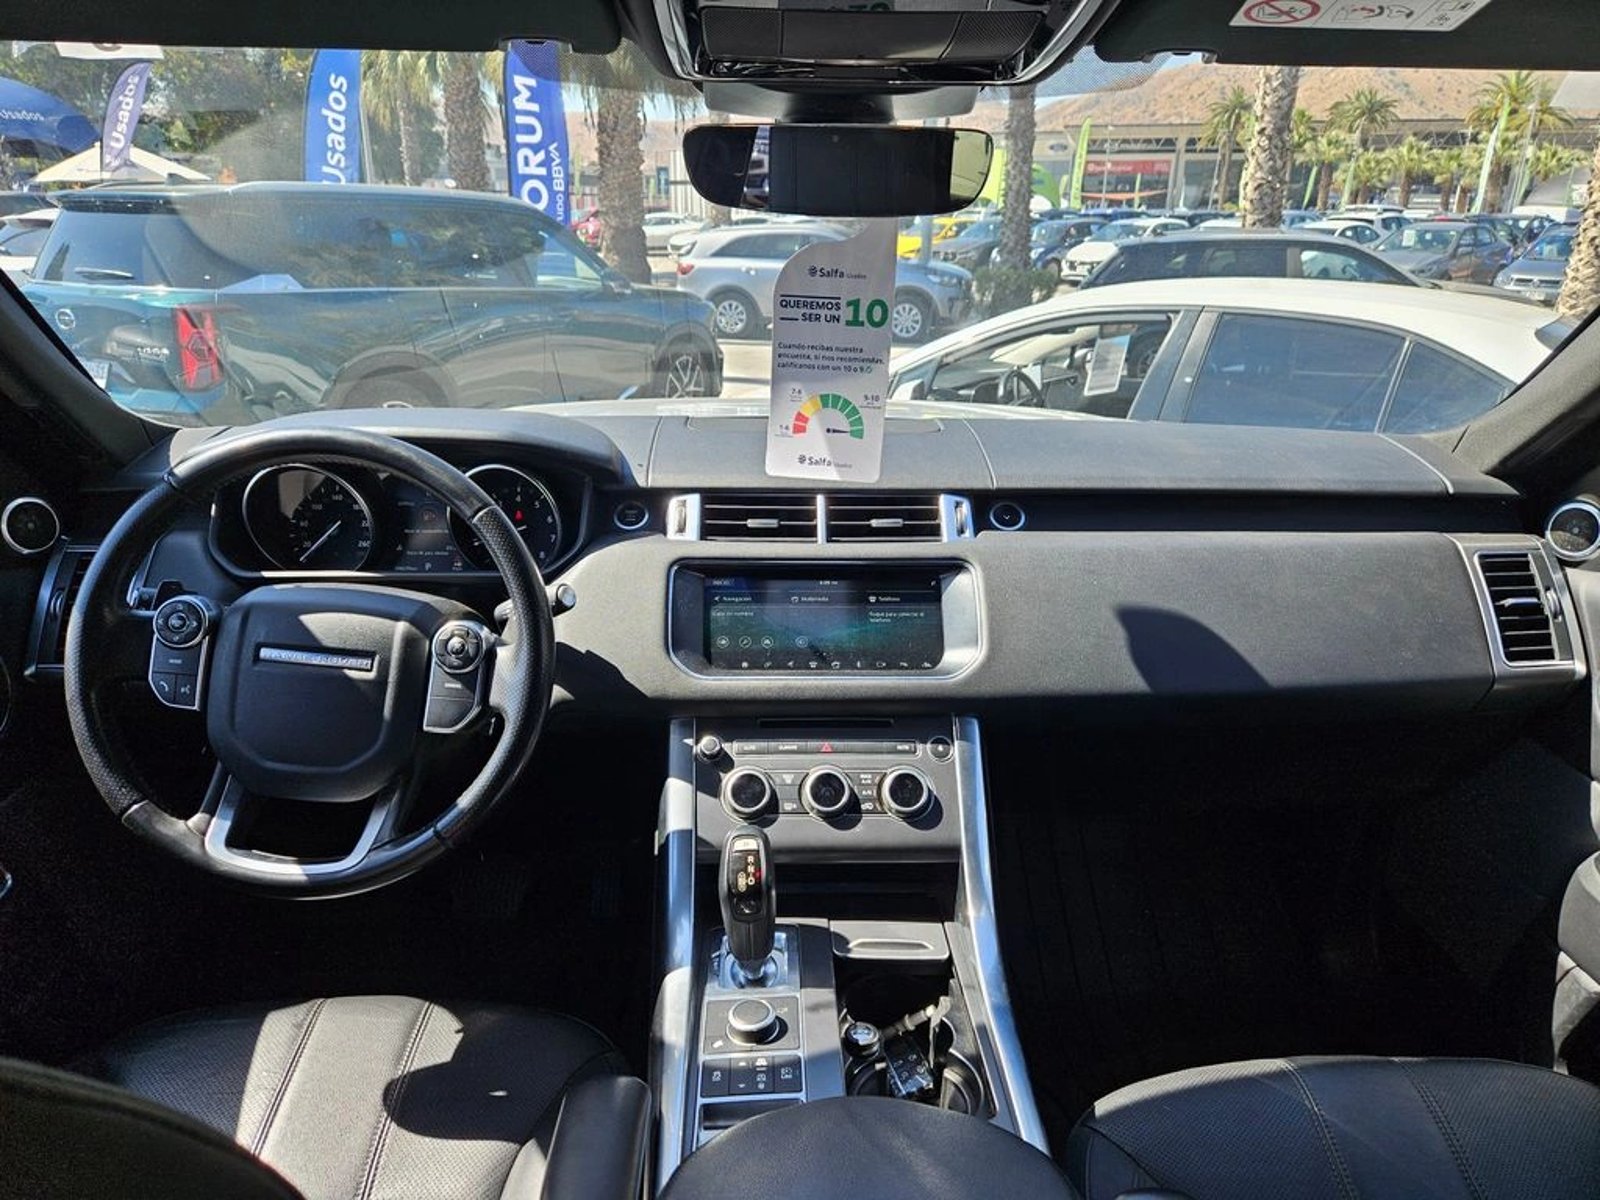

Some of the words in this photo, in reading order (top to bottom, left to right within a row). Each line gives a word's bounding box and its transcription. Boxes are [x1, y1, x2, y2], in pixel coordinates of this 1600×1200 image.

[110, 75, 140, 149] Usados
[321, 73, 348, 185] Usados
[548, 142, 565, 191] BBVA
[819, 267, 845, 279] Salfa
[780, 299, 841, 312] QUEREMOS
[801, 312, 821, 323] SER
[824, 314, 840, 324] UN
[845, 298, 889, 328] 10
[778, 342, 806, 350] Cuando
[807, 344, 833, 352] recibas
[808, 456, 832, 467] Salfa
